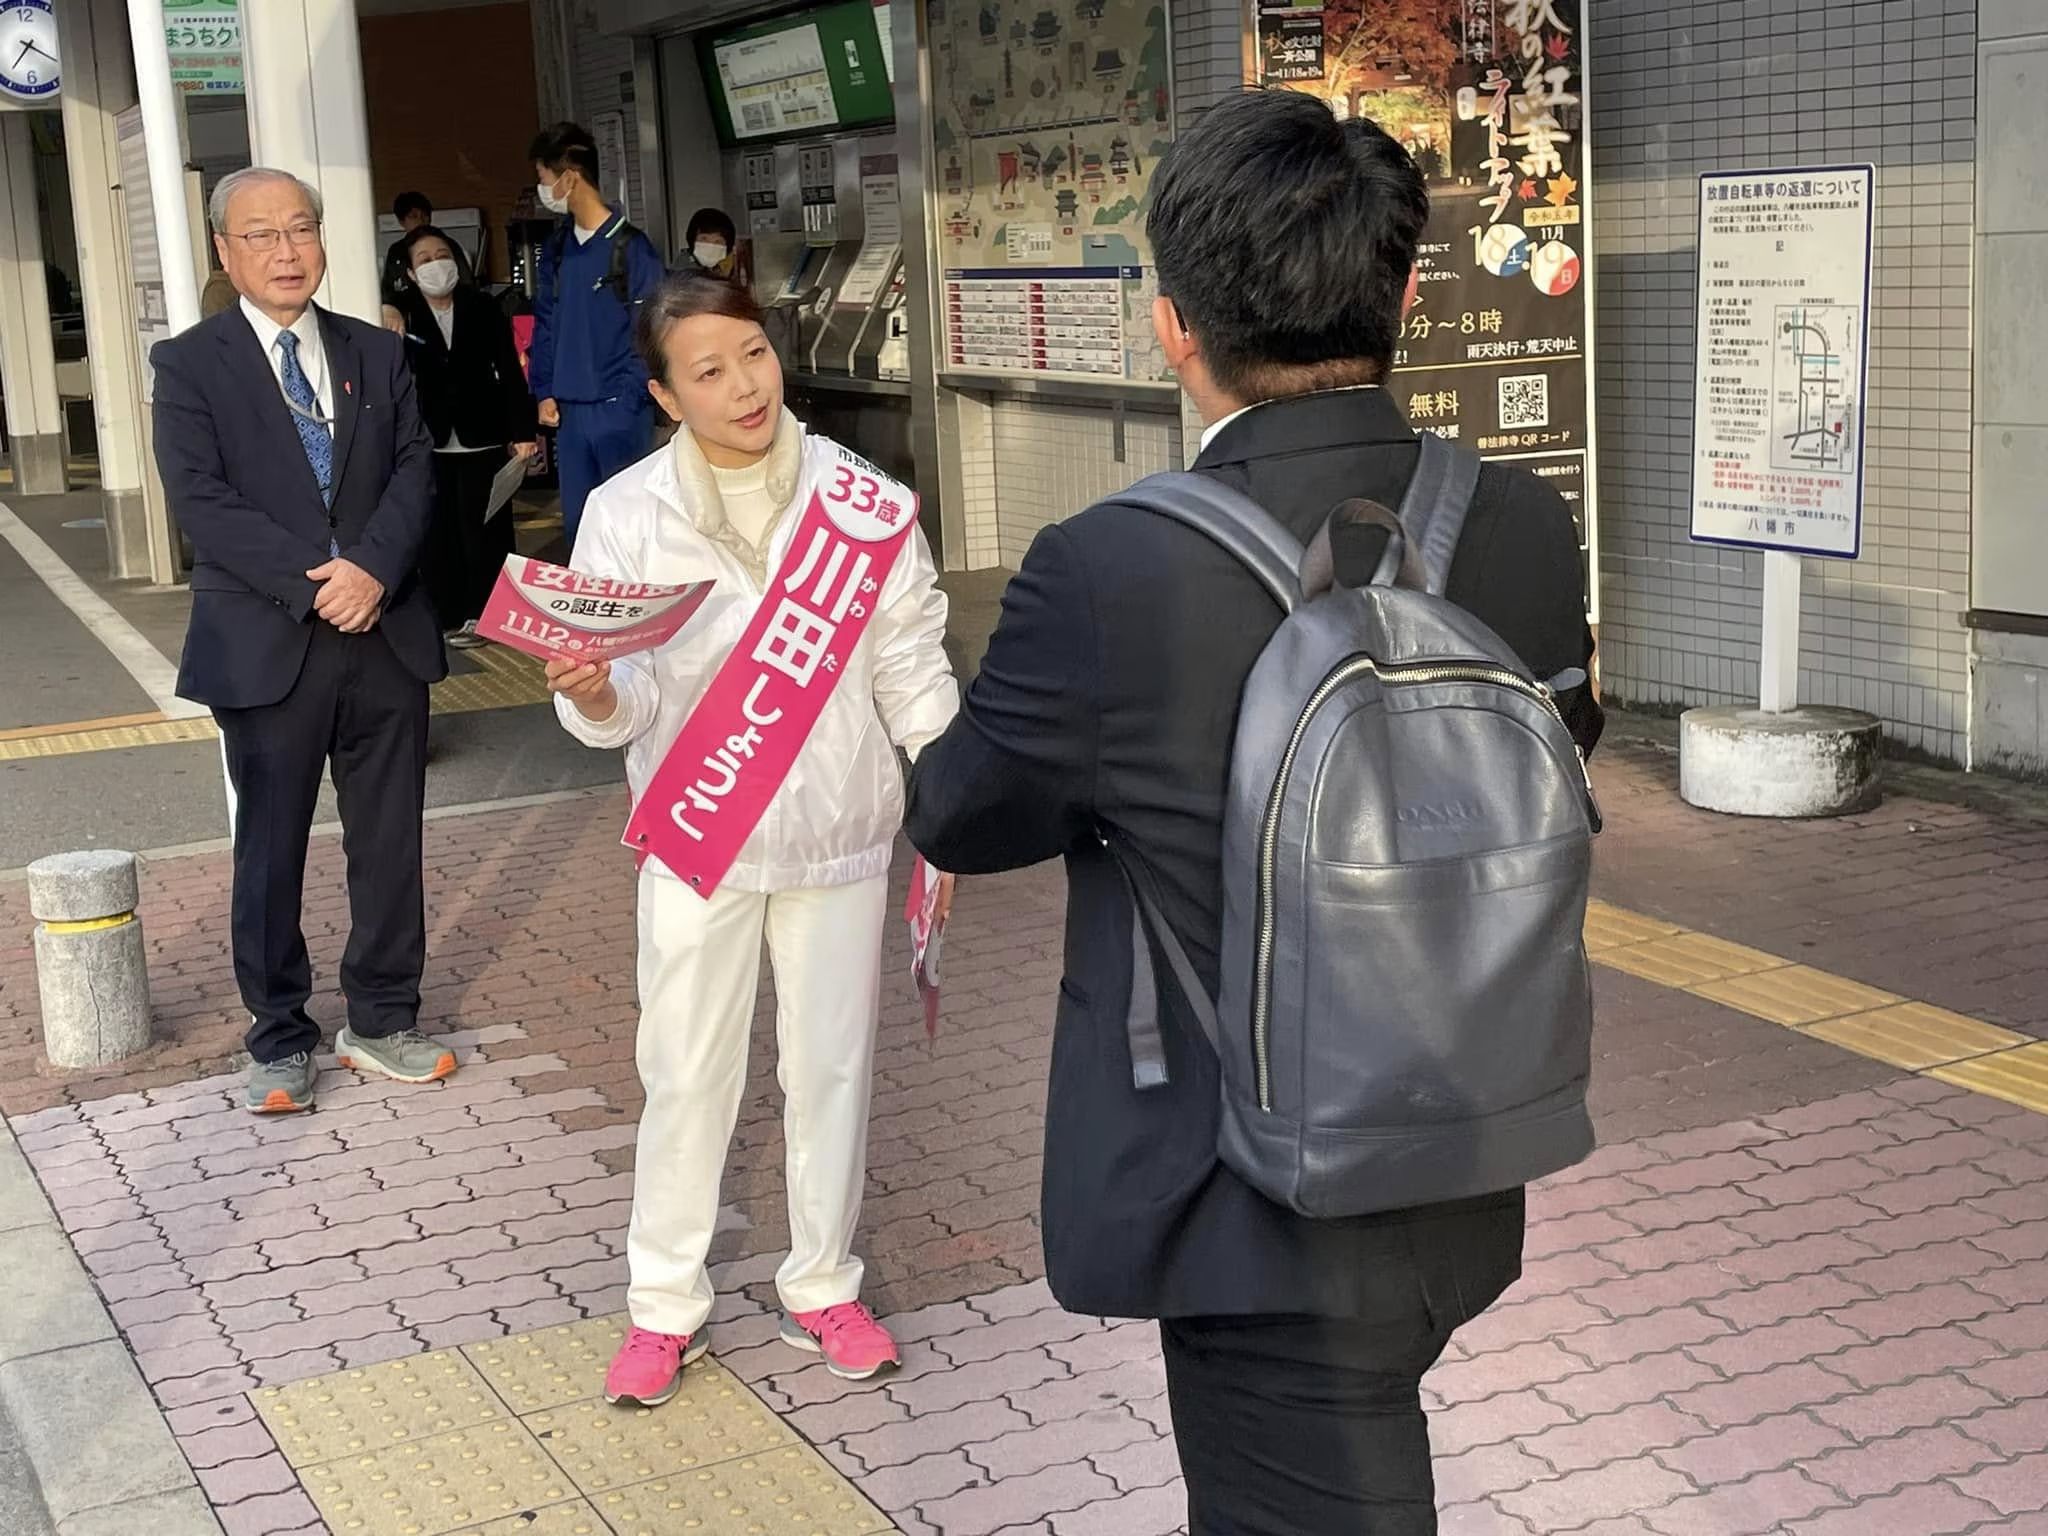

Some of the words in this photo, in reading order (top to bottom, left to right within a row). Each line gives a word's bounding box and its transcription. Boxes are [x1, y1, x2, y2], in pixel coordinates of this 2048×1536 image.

[17, 9, 33, 23] 12
[28, 71, 37, 84] 6
[1479, 69, 1514, 223] ライトアップ
[1707, 179, 1862, 200] 放置自転車等の返還について
[1540, 226, 1564, 241] 11月
[1409, 390, 1460, 419] 無料
[1521, 435, 1538, 447] QR
[1540, 431, 1571, 443] コード
[826, 465, 901, 527] 33歳
[504, 610, 570, 646] 11.12
[671, 526, 873, 841] 川田しょうこ
